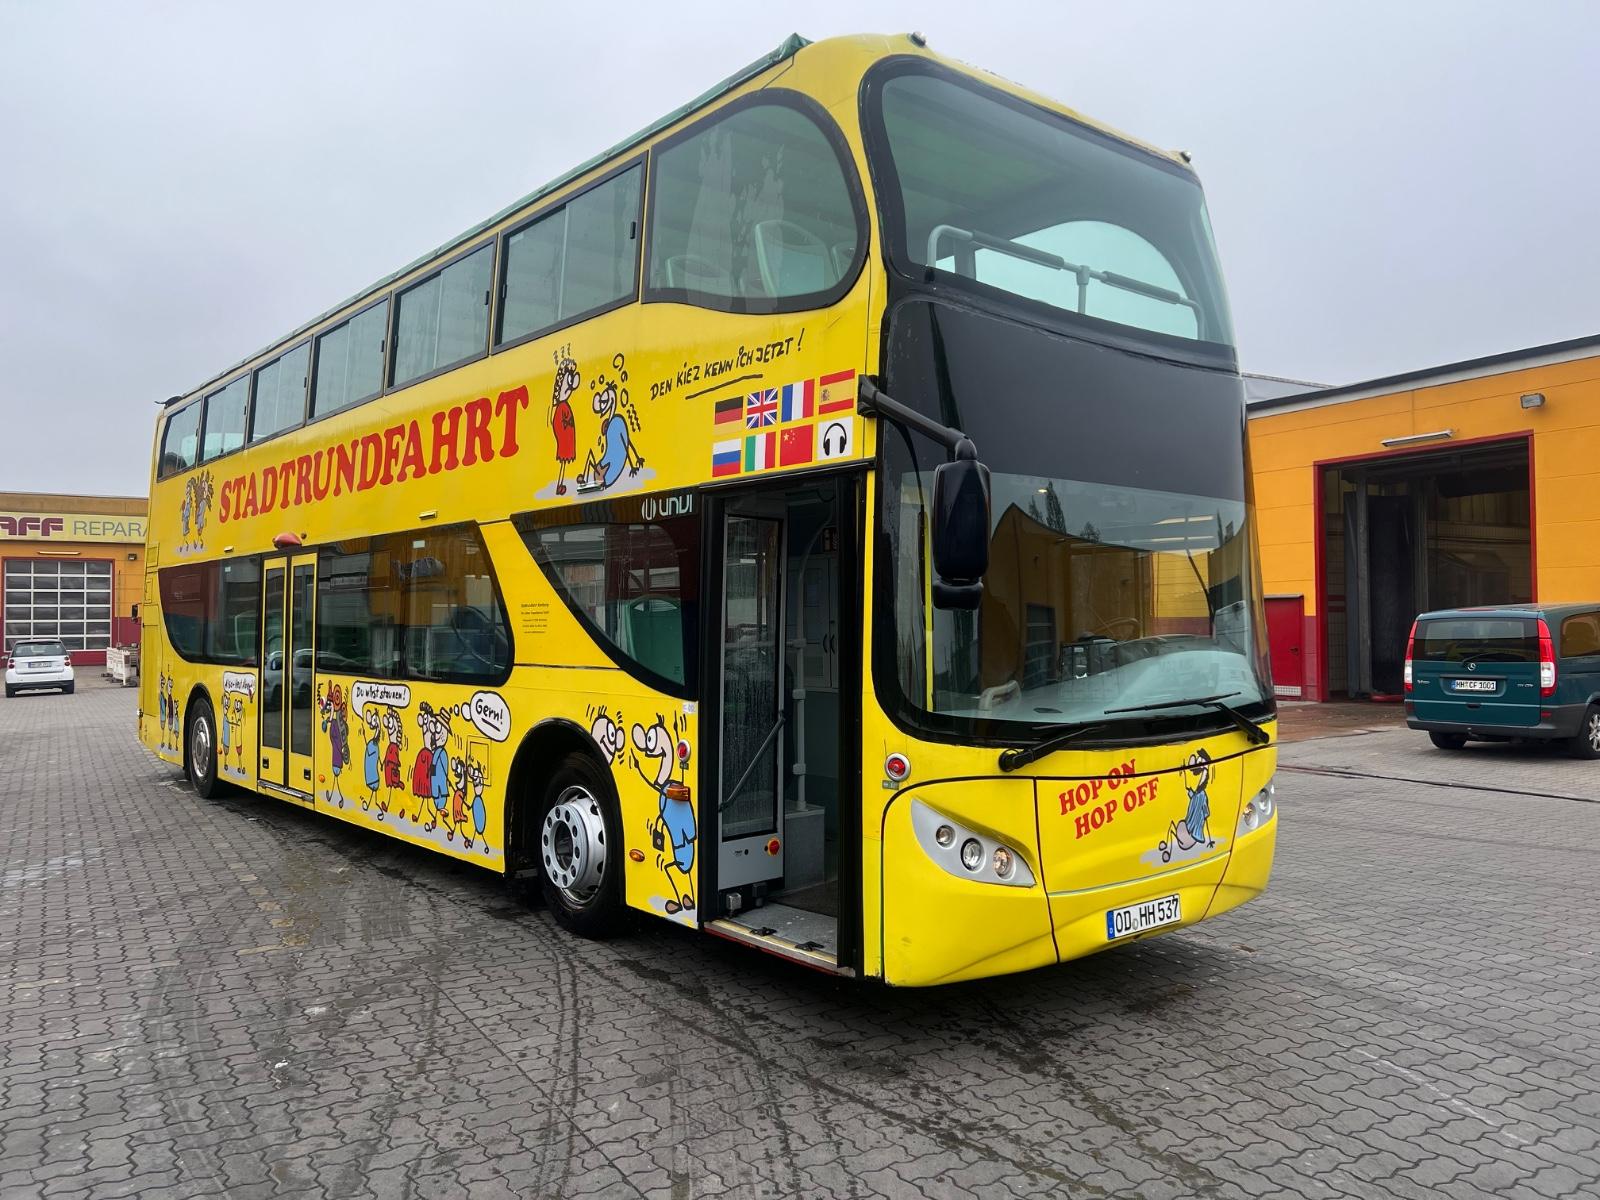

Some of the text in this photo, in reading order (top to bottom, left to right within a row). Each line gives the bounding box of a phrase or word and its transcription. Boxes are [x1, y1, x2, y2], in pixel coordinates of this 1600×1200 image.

[650, 377, 672, 401] DEN
[704, 359, 733, 379] KENN
[219, 385, 529, 523] STADTRUNDFAHRT
[73, 520, 147, 537] REPAR
[475, 698, 503, 725] Gern!
[1059, 758, 1136, 815] HOP ON
[1074, 777, 1159, 839] HOP OFF
[1116, 910, 1132, 933] OD
[1139, 904, 1156, 927] HH
[1157, 898, 1179, 922] 537
